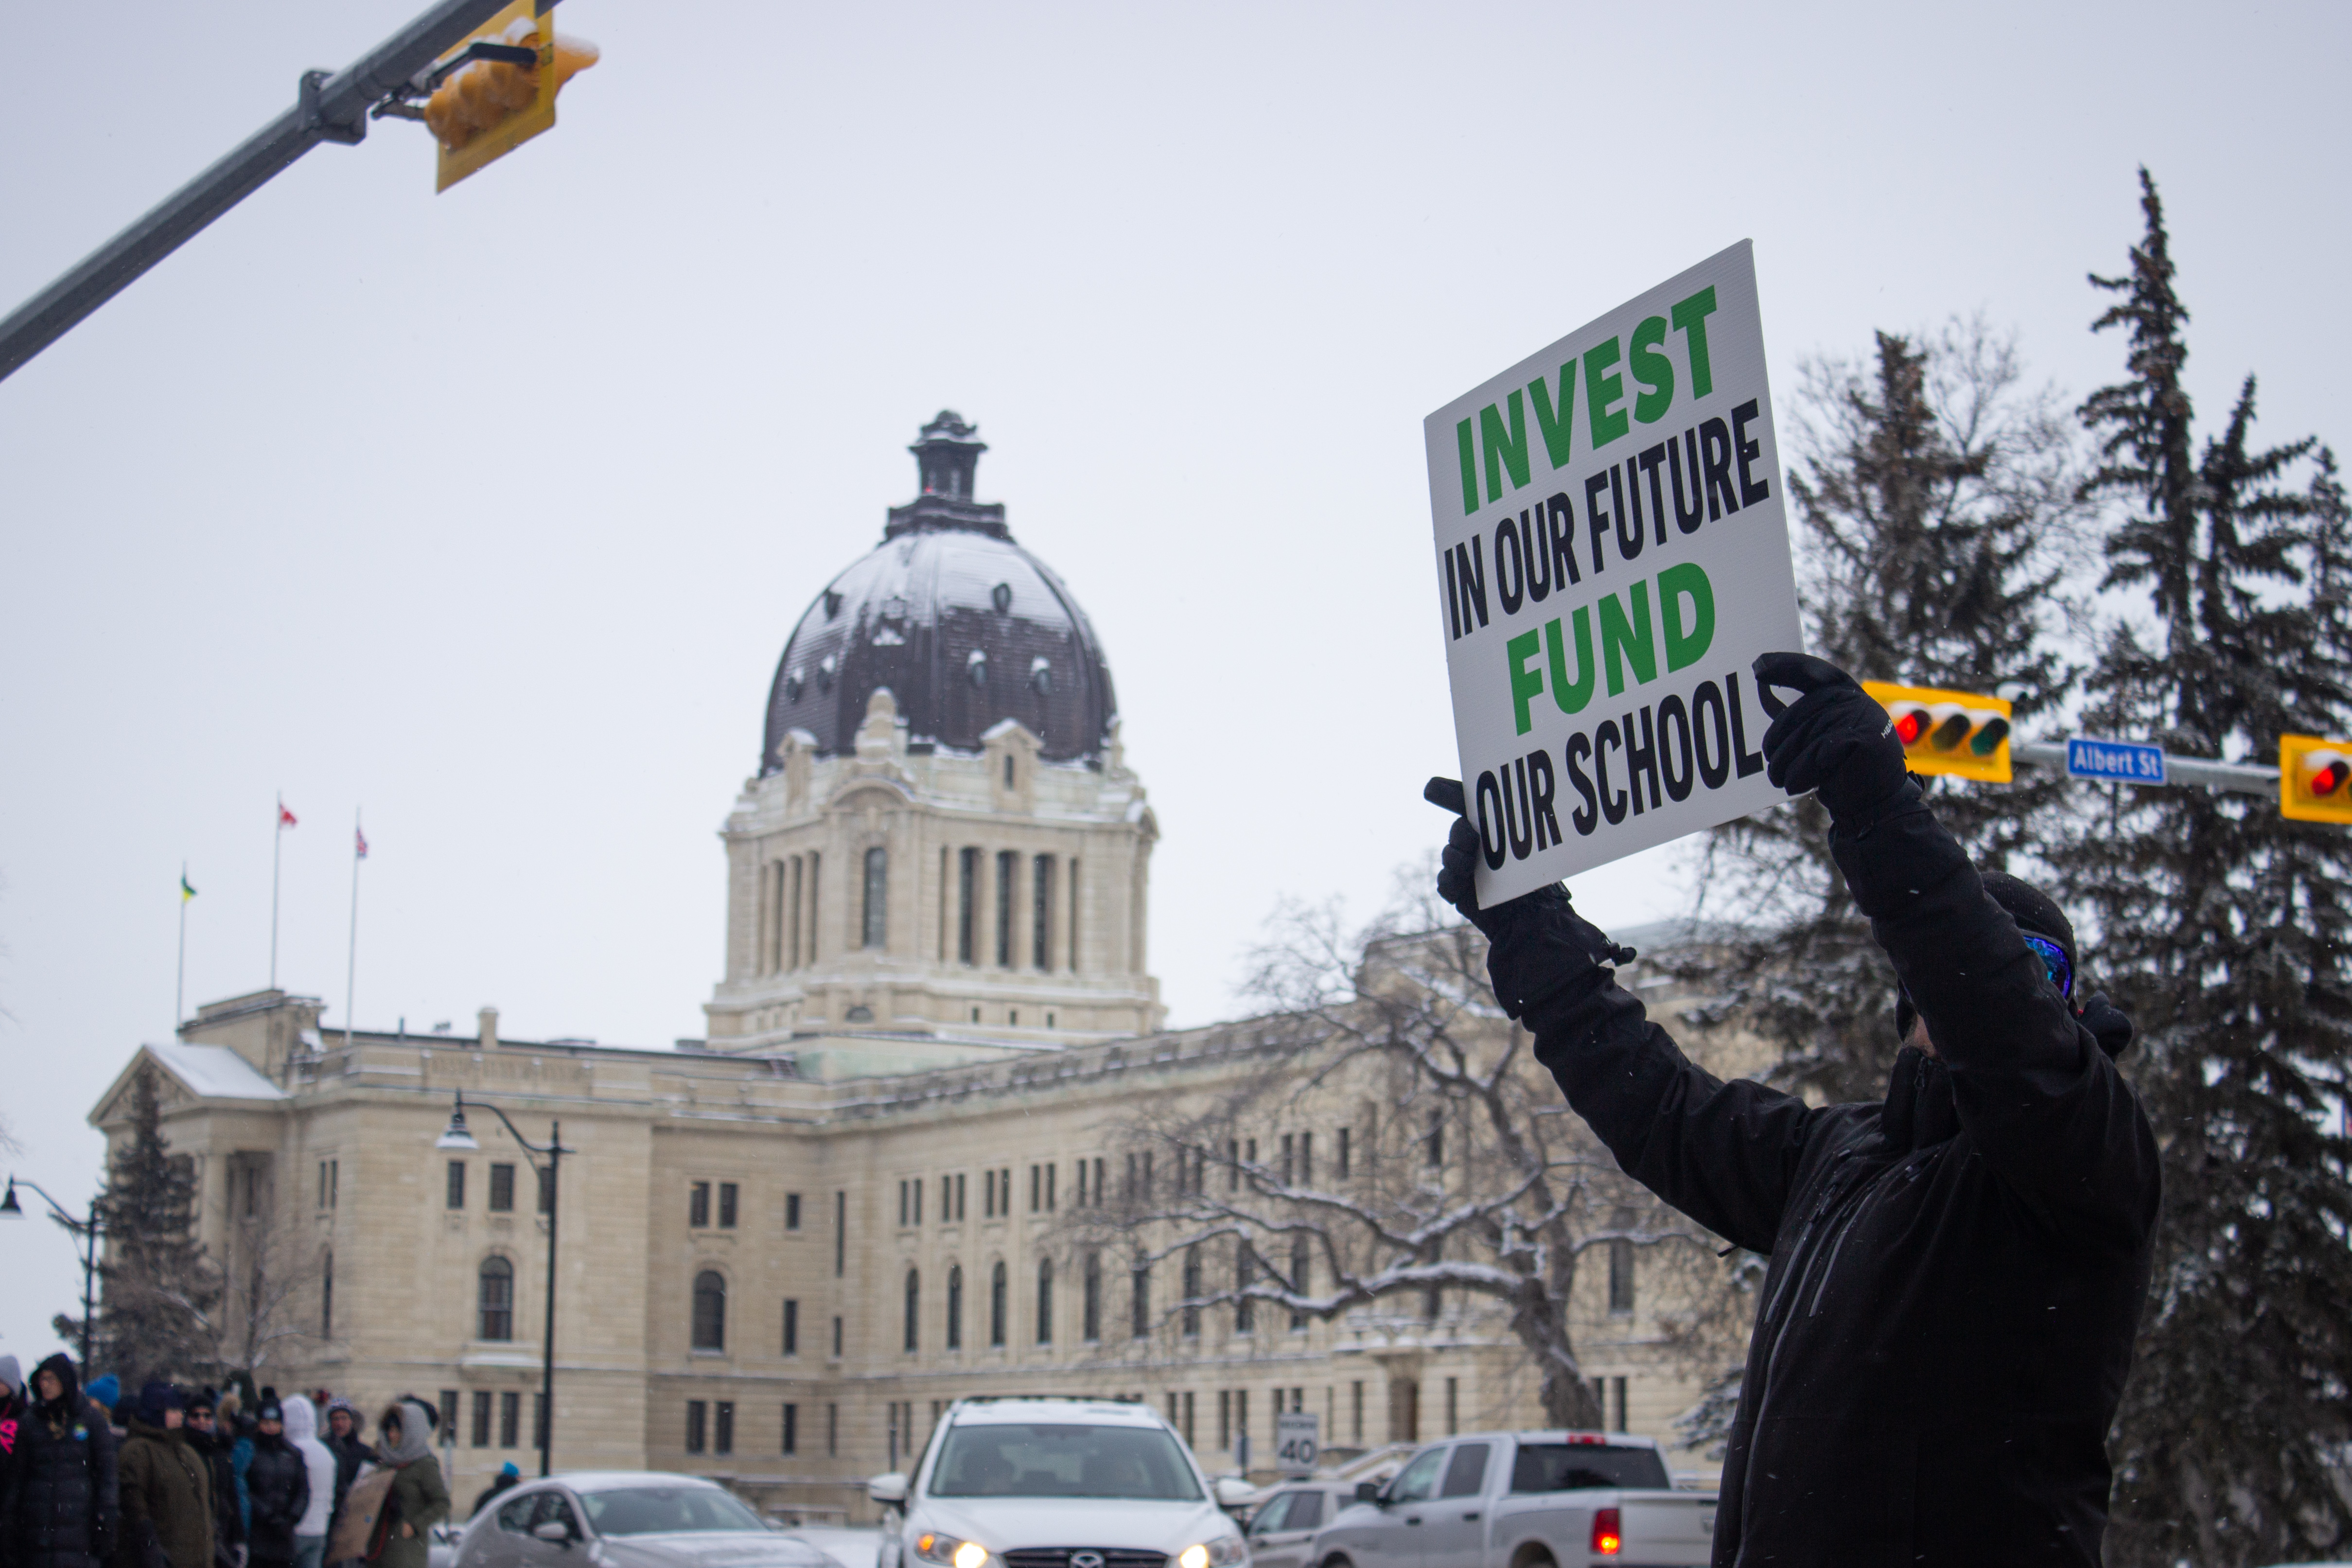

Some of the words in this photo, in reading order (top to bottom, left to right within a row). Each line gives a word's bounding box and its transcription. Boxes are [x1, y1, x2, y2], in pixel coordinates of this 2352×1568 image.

[1457, 285, 1717, 516] INVEST
[1445, 534, 1489, 640] IN
[1495, 492, 1581, 615] OUR
[1585, 398, 1770, 574] FUTURE
[1507, 563, 1715, 736] FUND
[1476, 750, 1562, 871] OUR
[2074, 744, 2135, 775] Albert
[2138, 750, 2159, 777] St
[1280, 1439, 1316, 1462] 40
